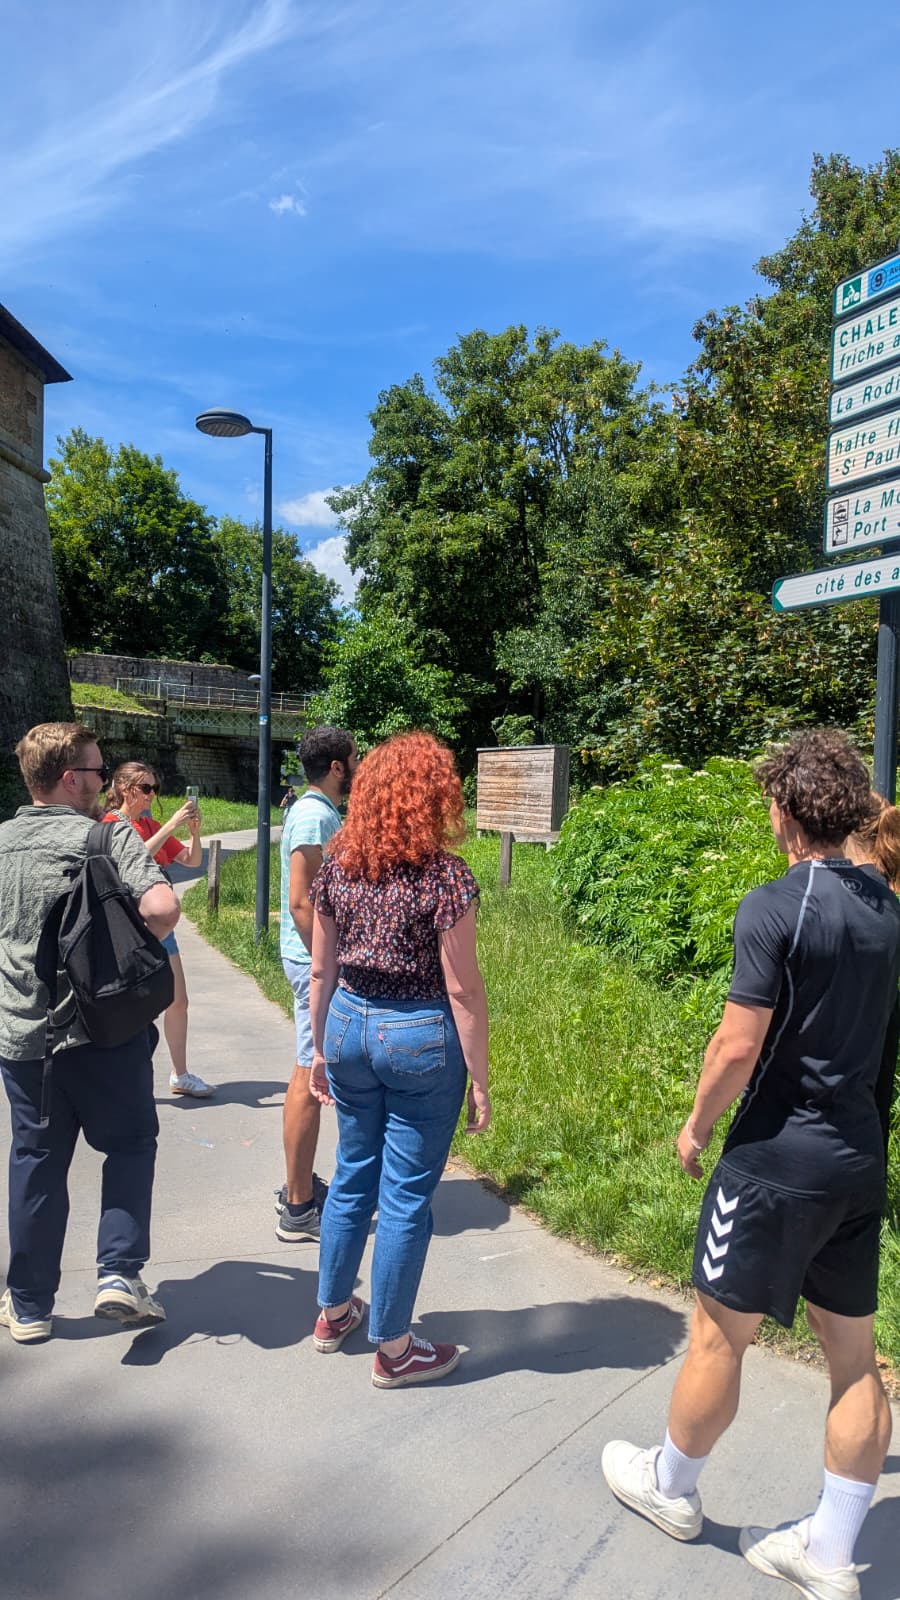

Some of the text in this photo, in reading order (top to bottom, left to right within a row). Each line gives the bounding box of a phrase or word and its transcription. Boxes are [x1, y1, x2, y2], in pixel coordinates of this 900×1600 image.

[874, 272, 883, 288] 9
[839, 307, 898, 348] CHALE
[839, 341, 884, 371] friche
[836, 374, 900, 414] La Rodi
[835, 431, 876, 456] halte
[854, 499, 871, 516] La
[853, 516, 887, 539] Port
[815, 574, 845, 595] cité
[854, 570, 881, 588] des
